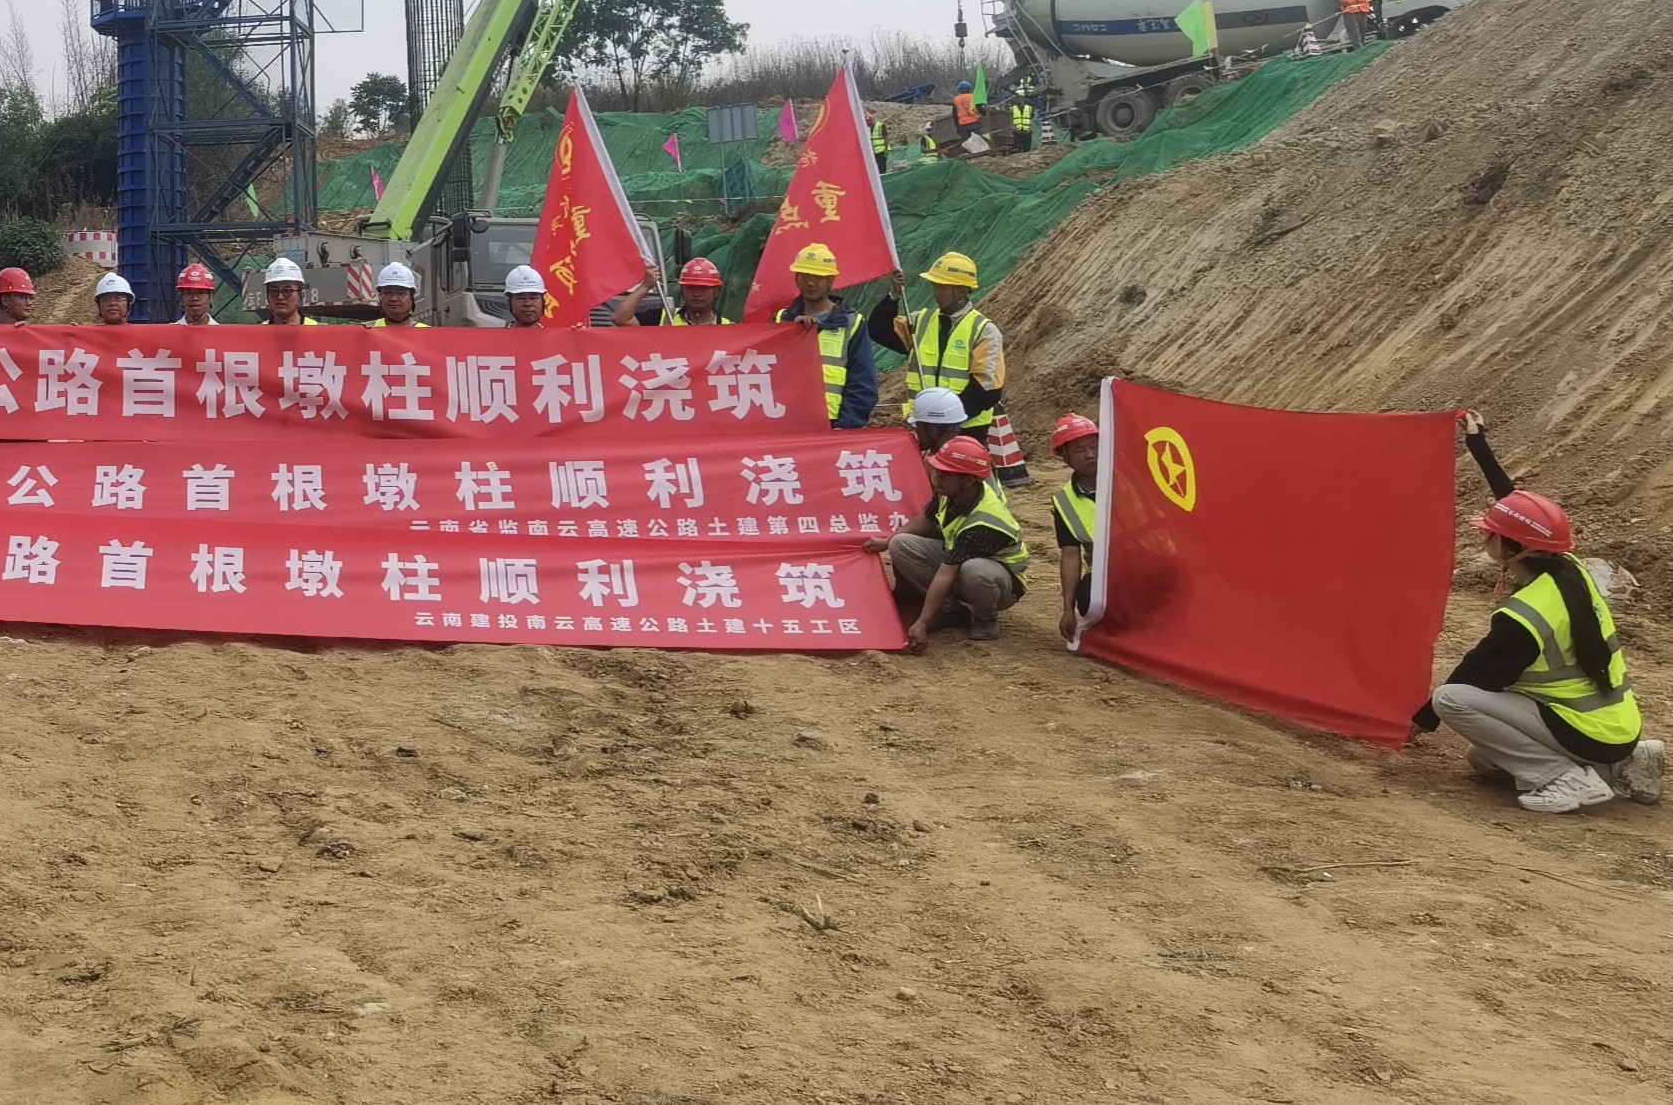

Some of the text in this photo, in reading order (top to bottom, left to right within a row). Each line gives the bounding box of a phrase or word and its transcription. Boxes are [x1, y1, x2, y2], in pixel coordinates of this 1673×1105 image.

[413, 611, 862, 635] 云南建投南云高速公路土建十五工区
